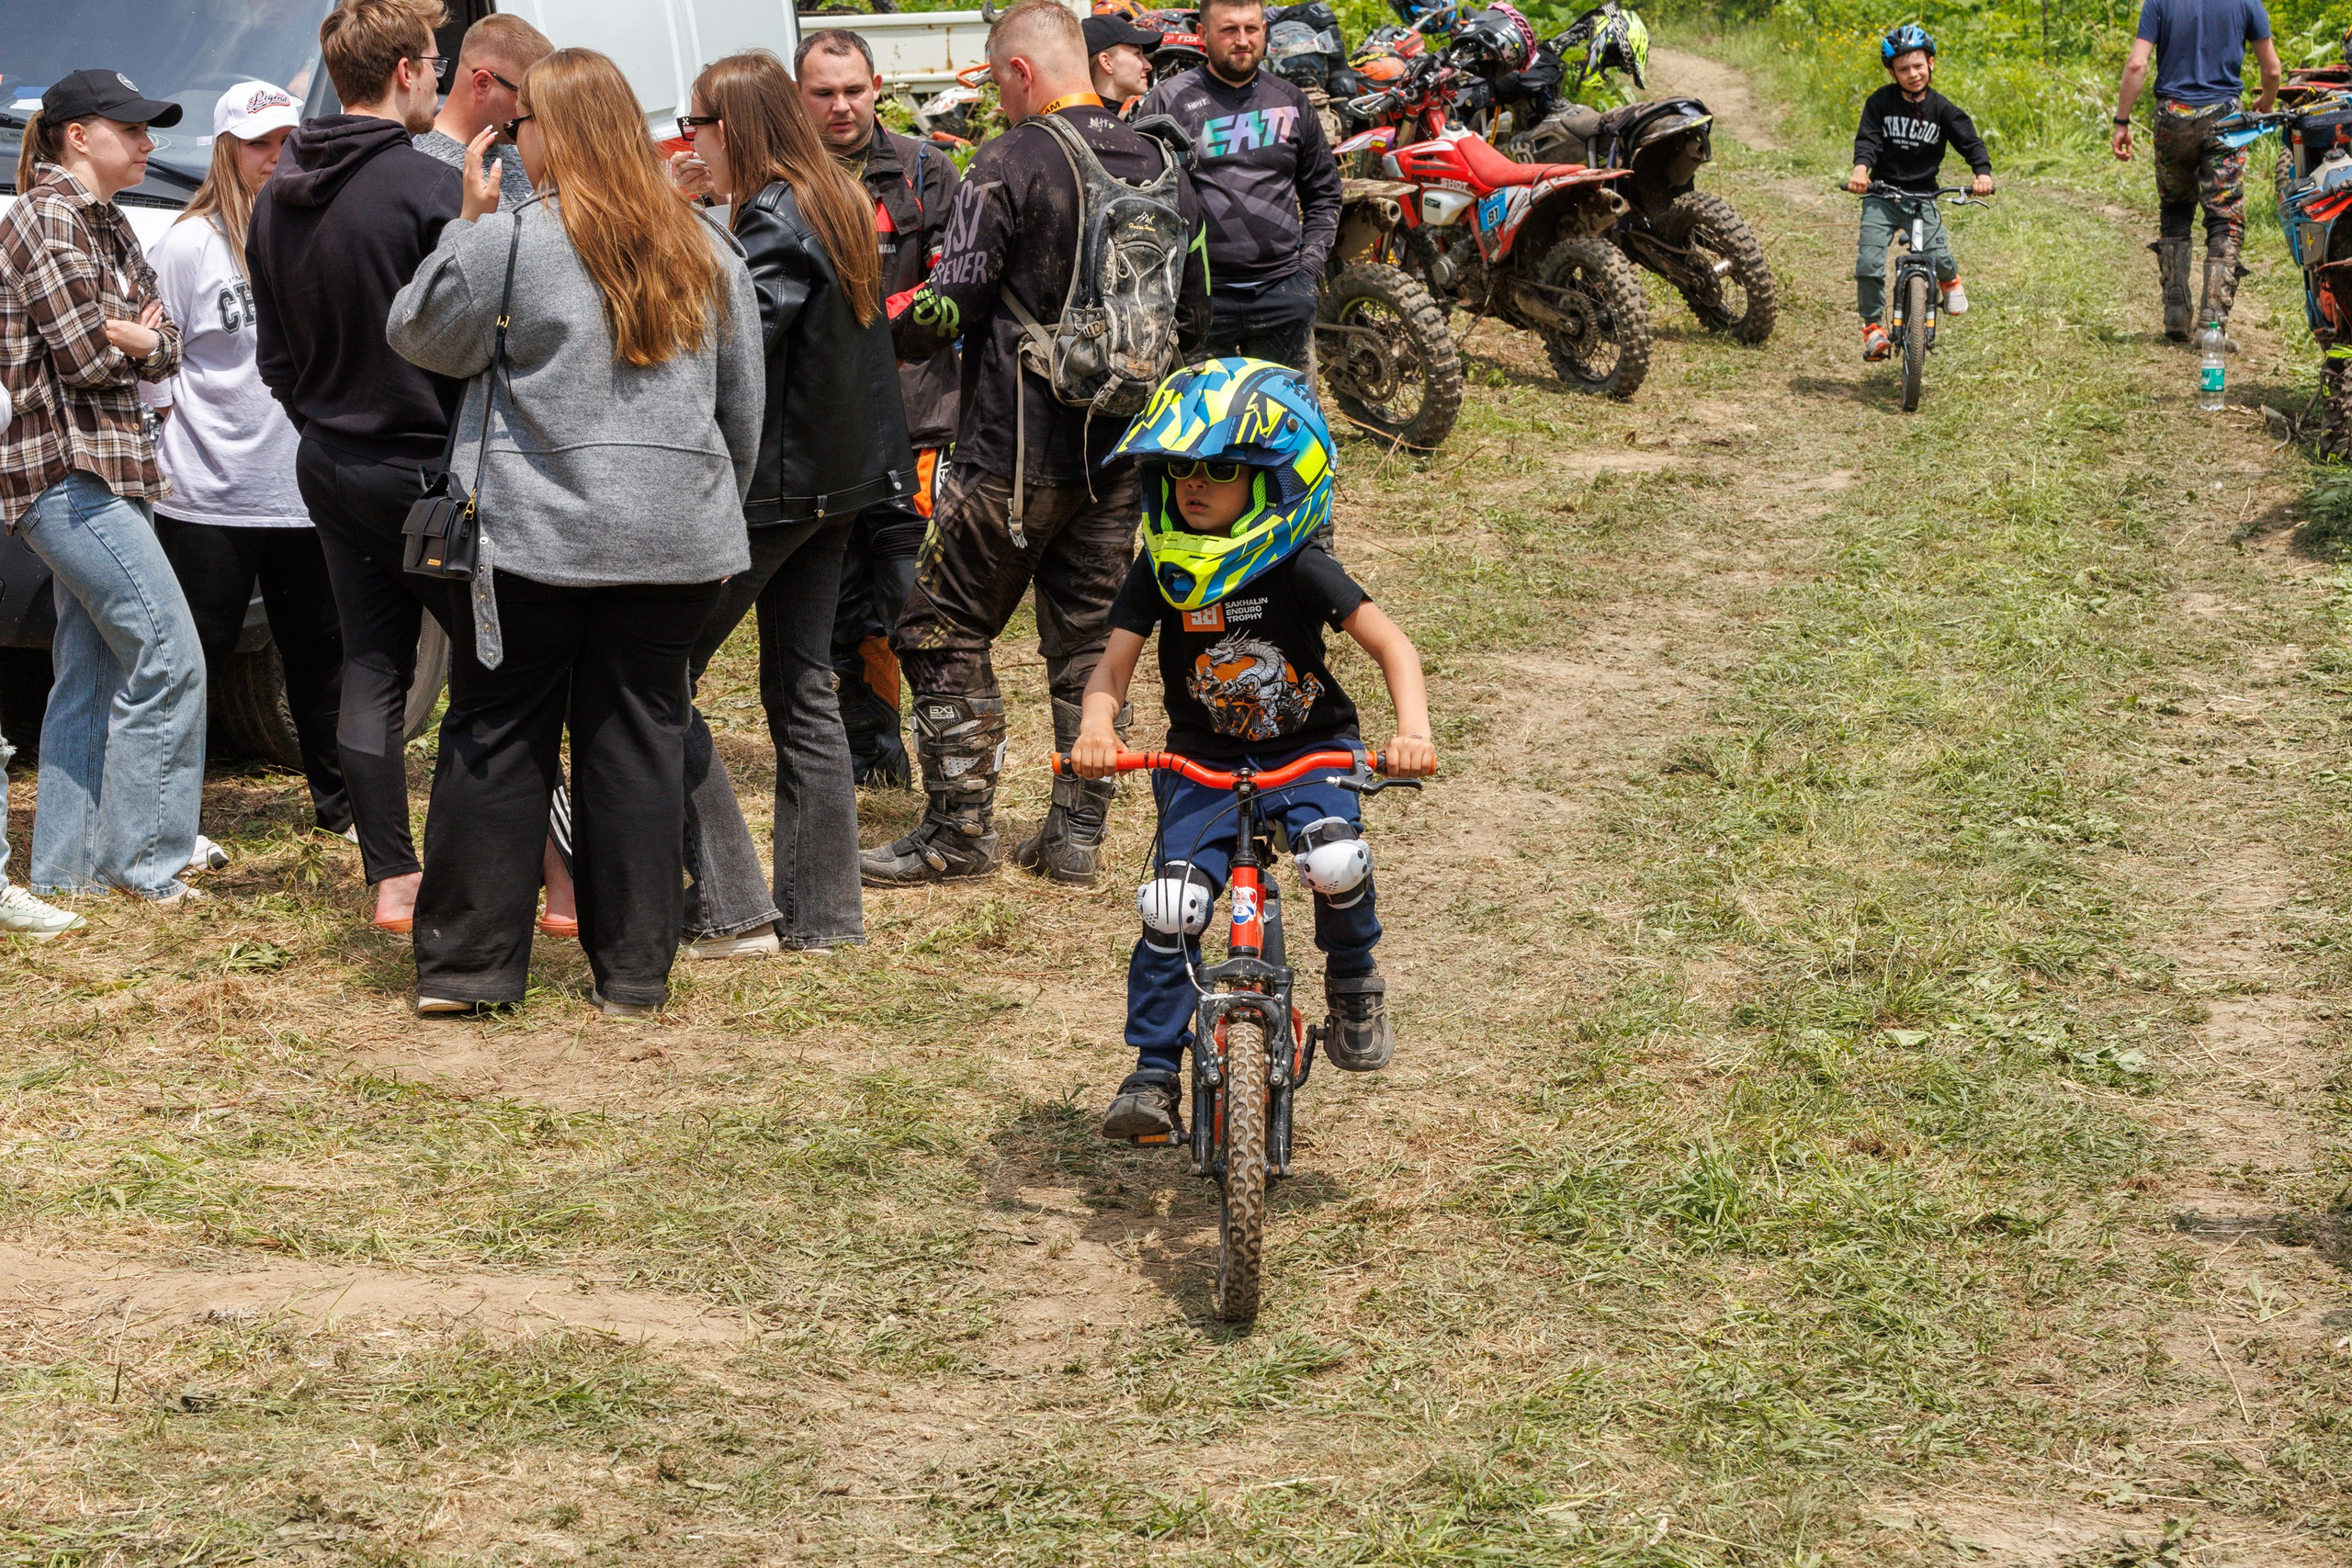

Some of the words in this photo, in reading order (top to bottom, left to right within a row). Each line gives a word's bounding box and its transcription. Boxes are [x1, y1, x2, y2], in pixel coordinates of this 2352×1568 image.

[1509, 12, 1536, 54] 100%
[1187, 98, 1207, 110] HPIT
[1193, 106, 1299, 159] EATT
[1487, 206, 1498, 226] 81
[1224, 596, 1269, 609] SAKHALIN
[1226, 605, 1262, 616] ENDURO
[1226, 612, 1263, 624] TROPHY
